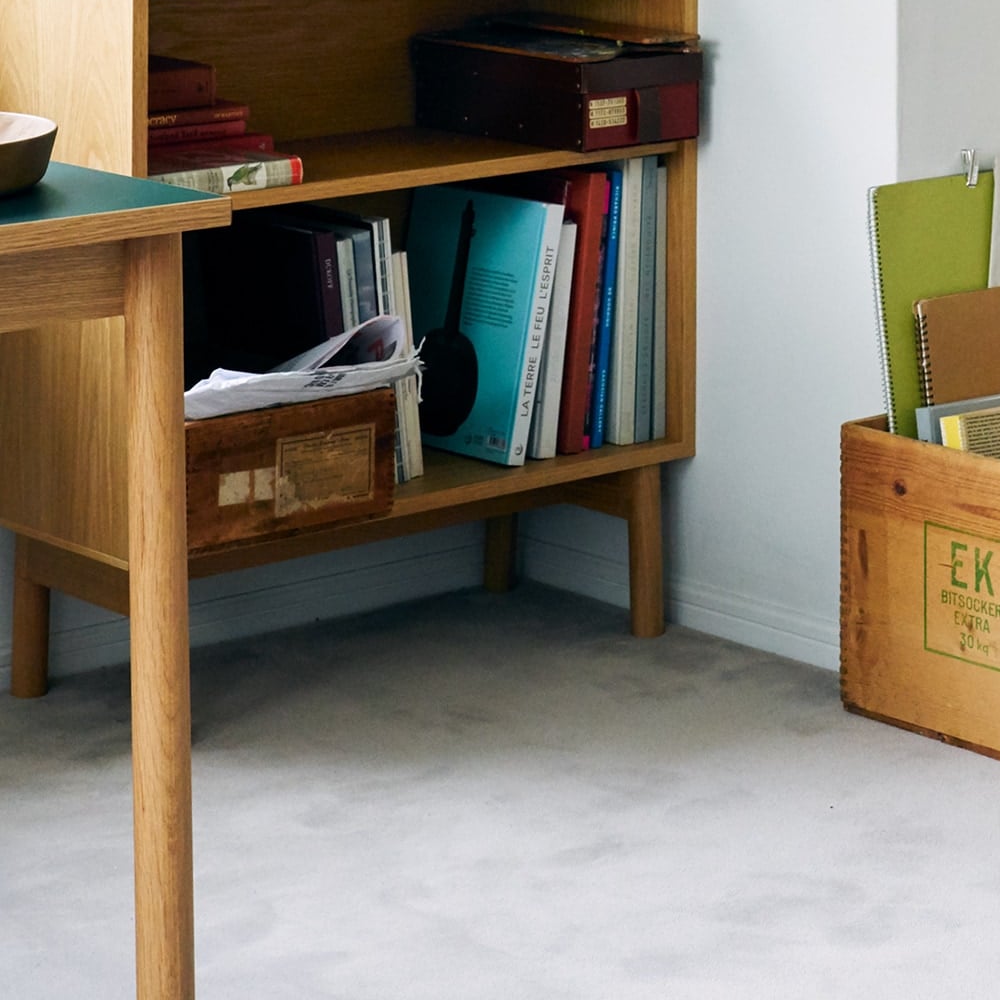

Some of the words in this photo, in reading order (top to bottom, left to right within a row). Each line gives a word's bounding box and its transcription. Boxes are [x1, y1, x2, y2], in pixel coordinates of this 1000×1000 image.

[539, 246, 554, 300] L'ESPRIT
[534, 306, 545, 332] FEU
[532, 333, 541, 349] LE
[524, 356, 537, 399] TERRE
[521, 399, 529, 417] LA
[951, 541, 995, 597] EK
[954, 611, 991, 633] EXTRA
[960, 632, 975, 649] 30
[976, 639, 990, 657] kg
